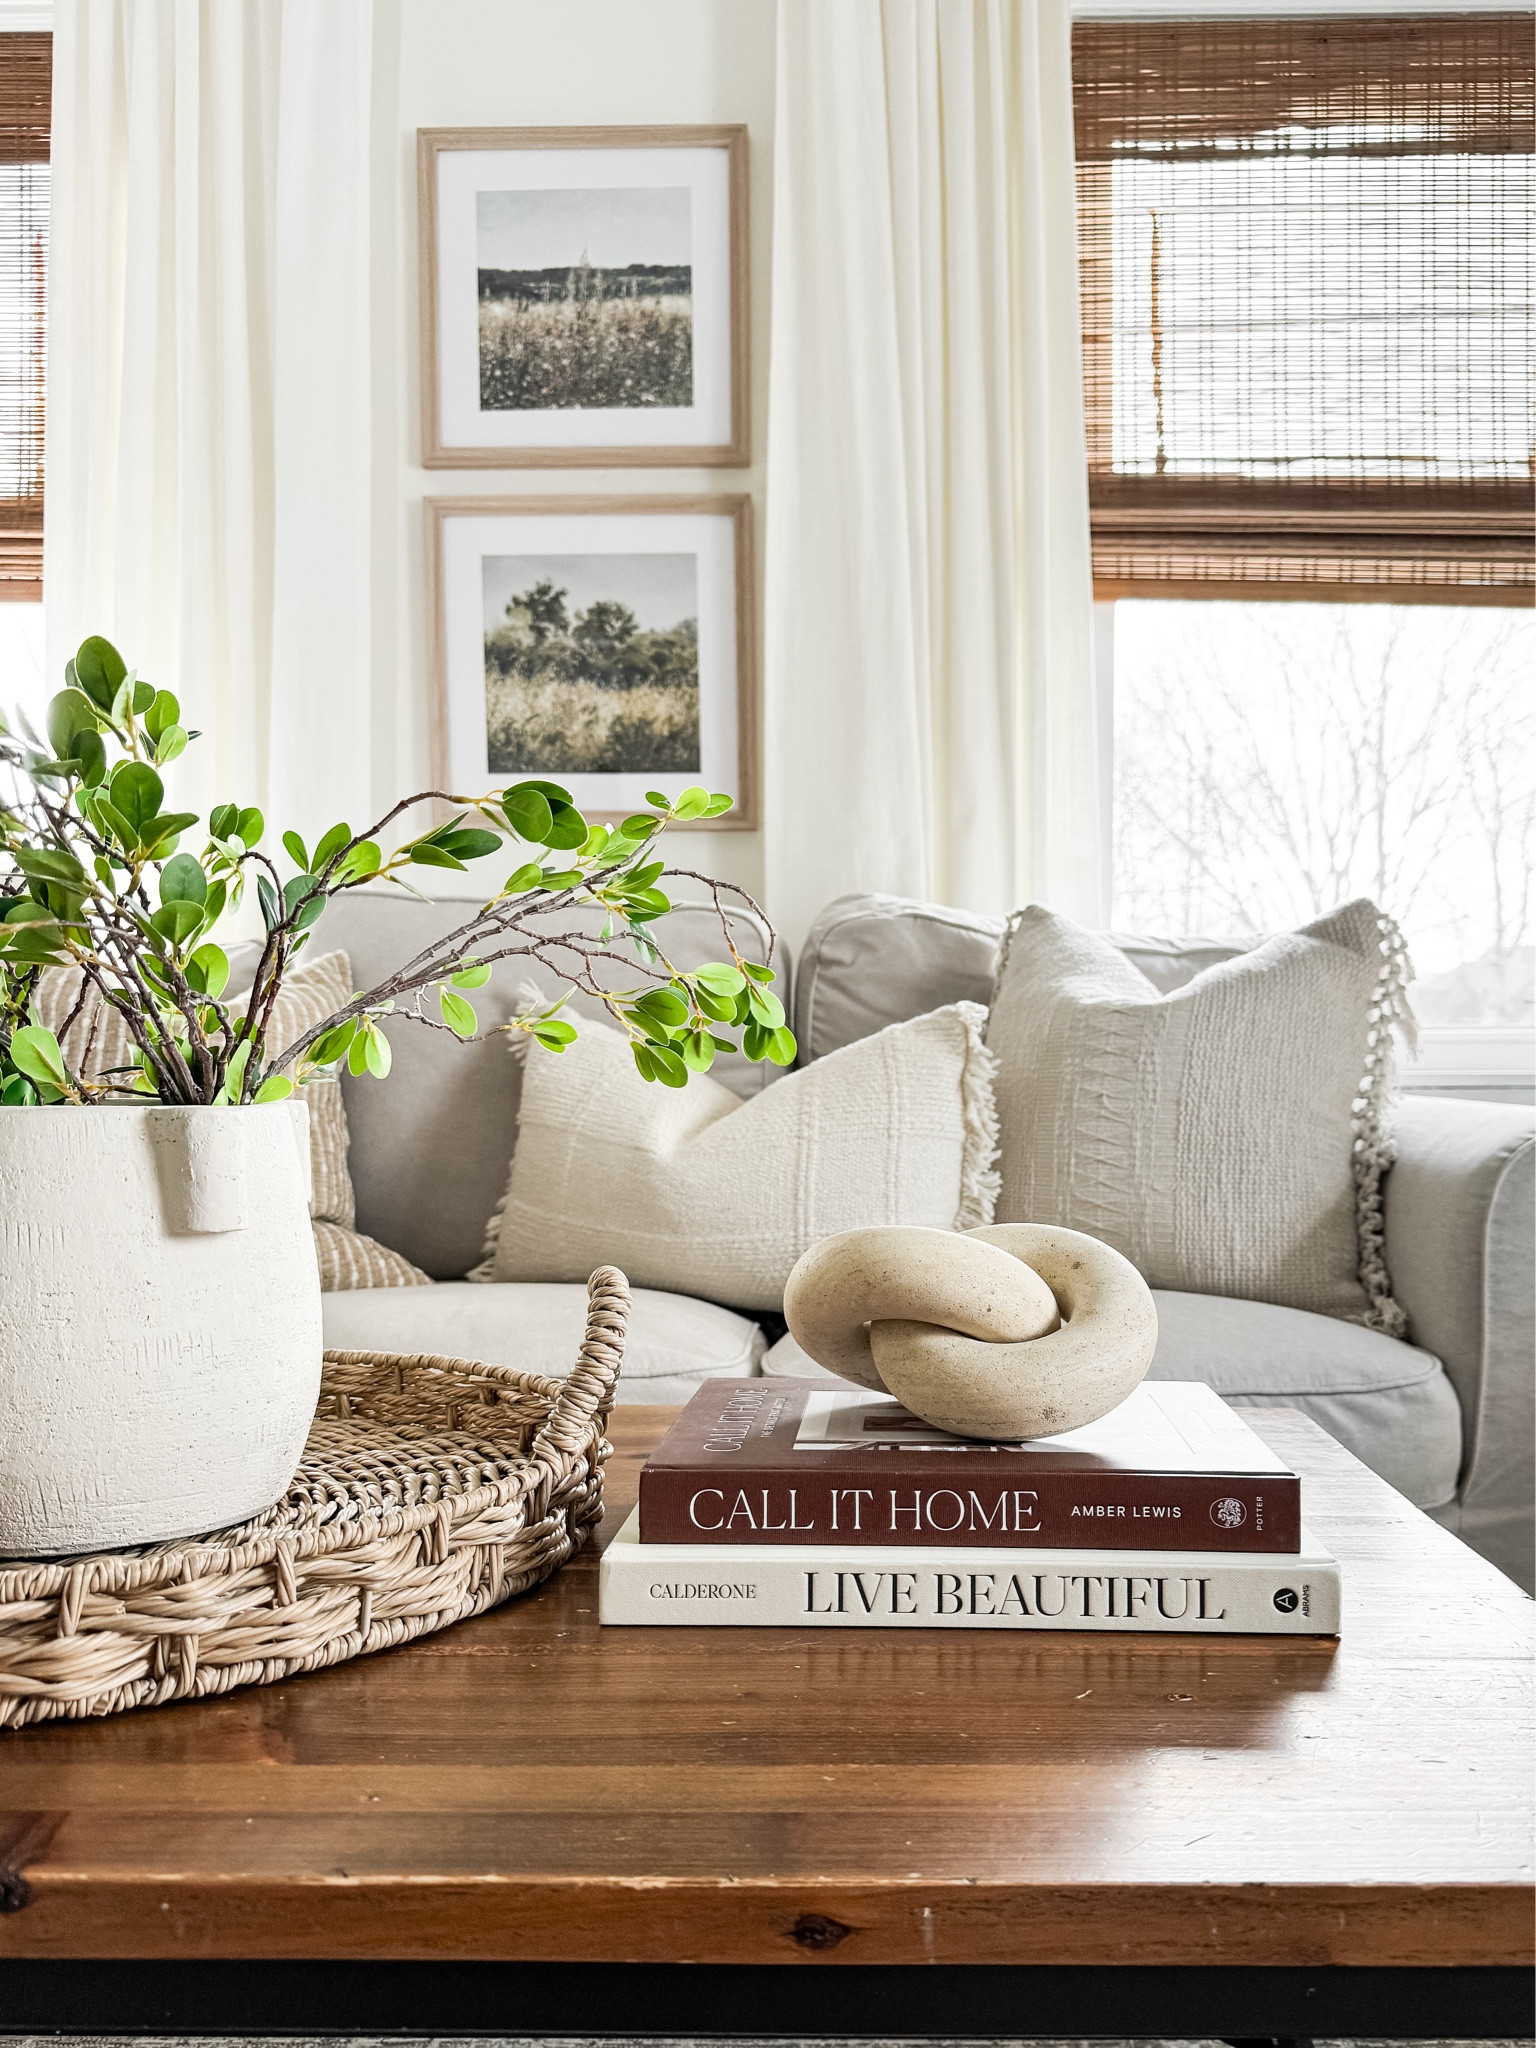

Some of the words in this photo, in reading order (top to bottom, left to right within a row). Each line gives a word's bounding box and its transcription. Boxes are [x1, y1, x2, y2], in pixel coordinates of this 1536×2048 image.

[723, 1387, 769, 1413] HOME
[717, 1414, 756, 1423] IT
[703, 1423, 752, 1452] CALL
[689, 1488, 815, 1531] CALL
[830, 1489, 874, 1531] IT
[889, 1489, 1043, 1532] HOME
[1071, 1504, 1126, 1517] AMBER
[1132, 1506, 1182, 1518] LEWIS
[1255, 1495, 1264, 1531] POTTER
[649, 1583, 757, 1600] CALDERONE
[803, 1572, 918, 1614] LIVE
[933, 1573, 1226, 1620] BEAUTIFUL
[1301, 1584, 1311, 1618] ABRAMS
